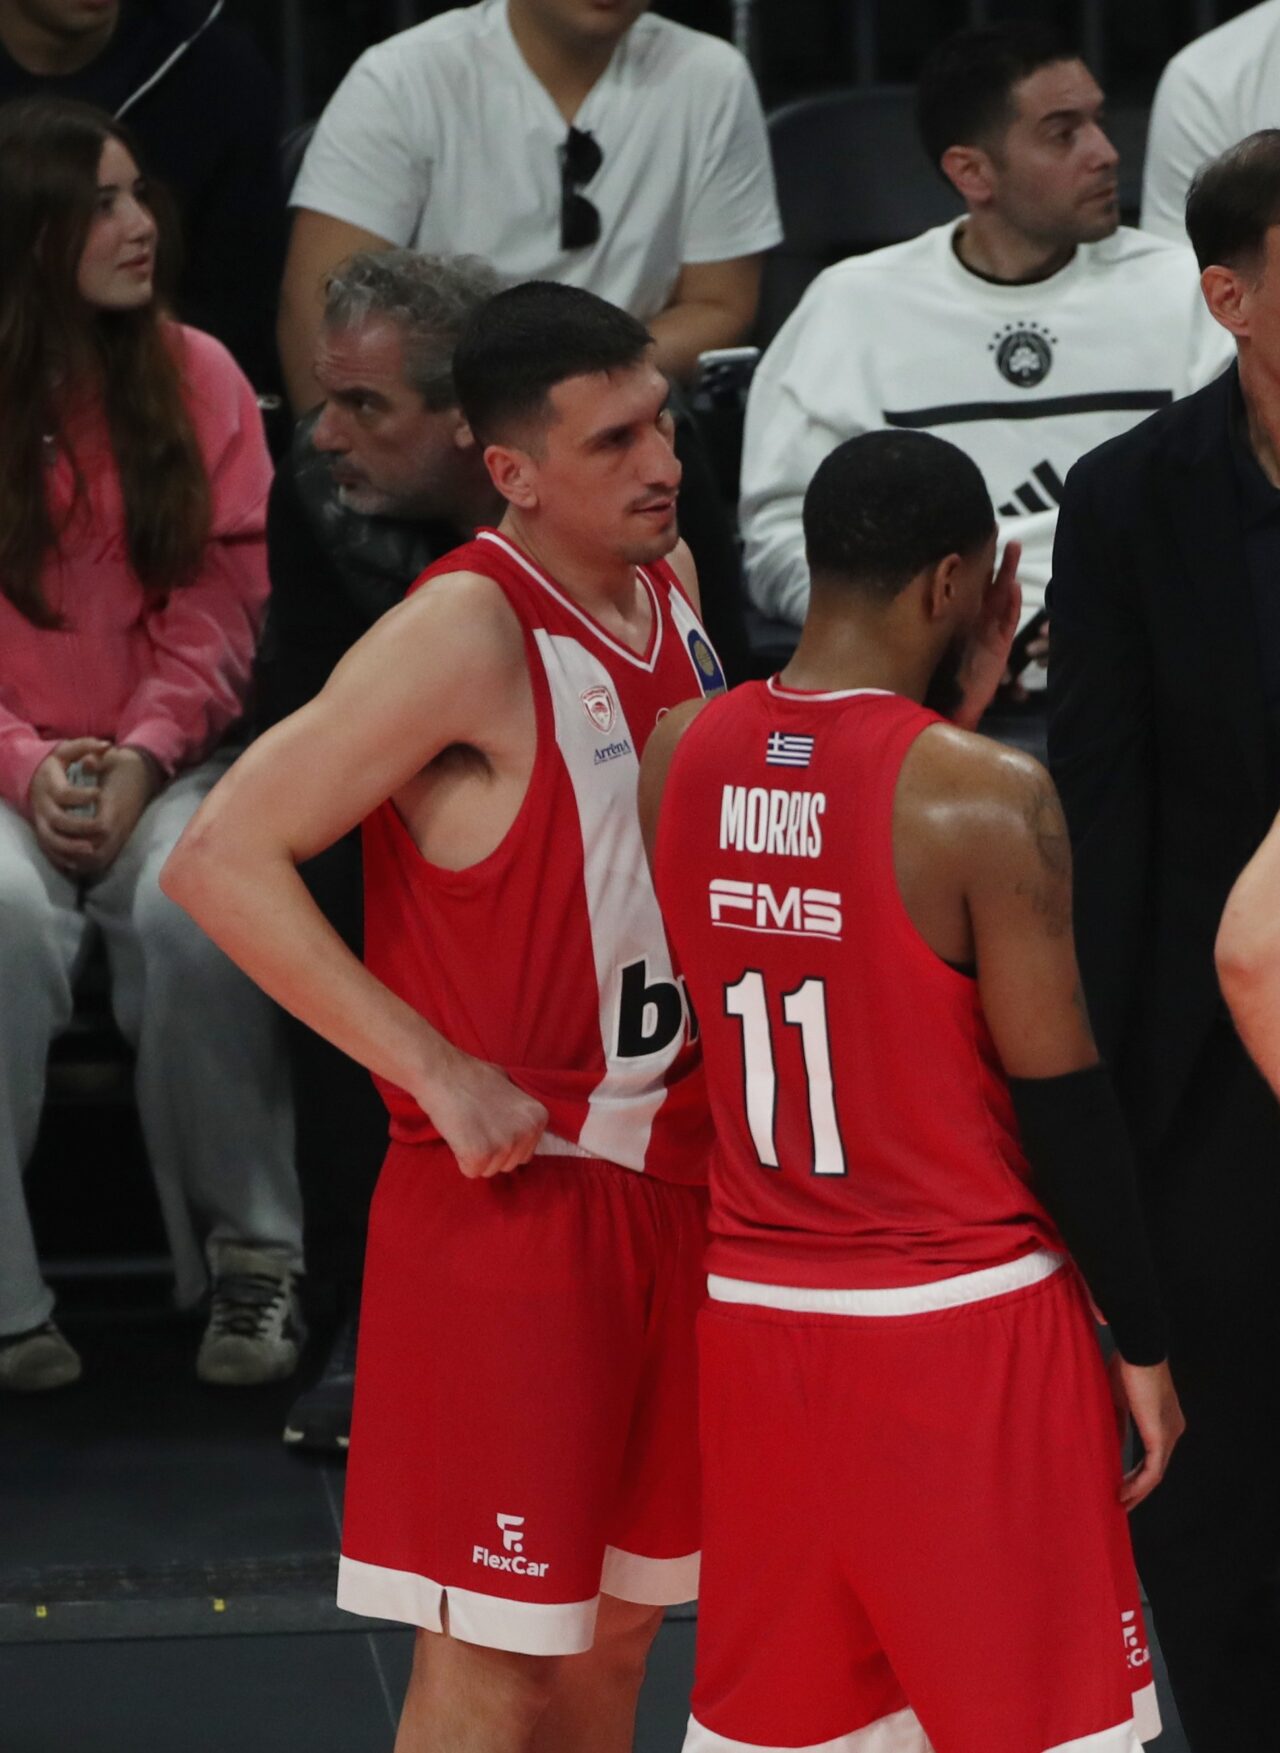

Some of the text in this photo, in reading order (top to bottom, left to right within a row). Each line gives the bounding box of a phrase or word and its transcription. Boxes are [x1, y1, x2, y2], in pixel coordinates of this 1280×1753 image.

[719, 784, 826, 859] MORRIS
[709, 879, 843, 935] FMS
[615, 955, 701, 1060] b
[724, 967, 848, 1178] 11
[472, 1544, 549, 1578] FlexCar
